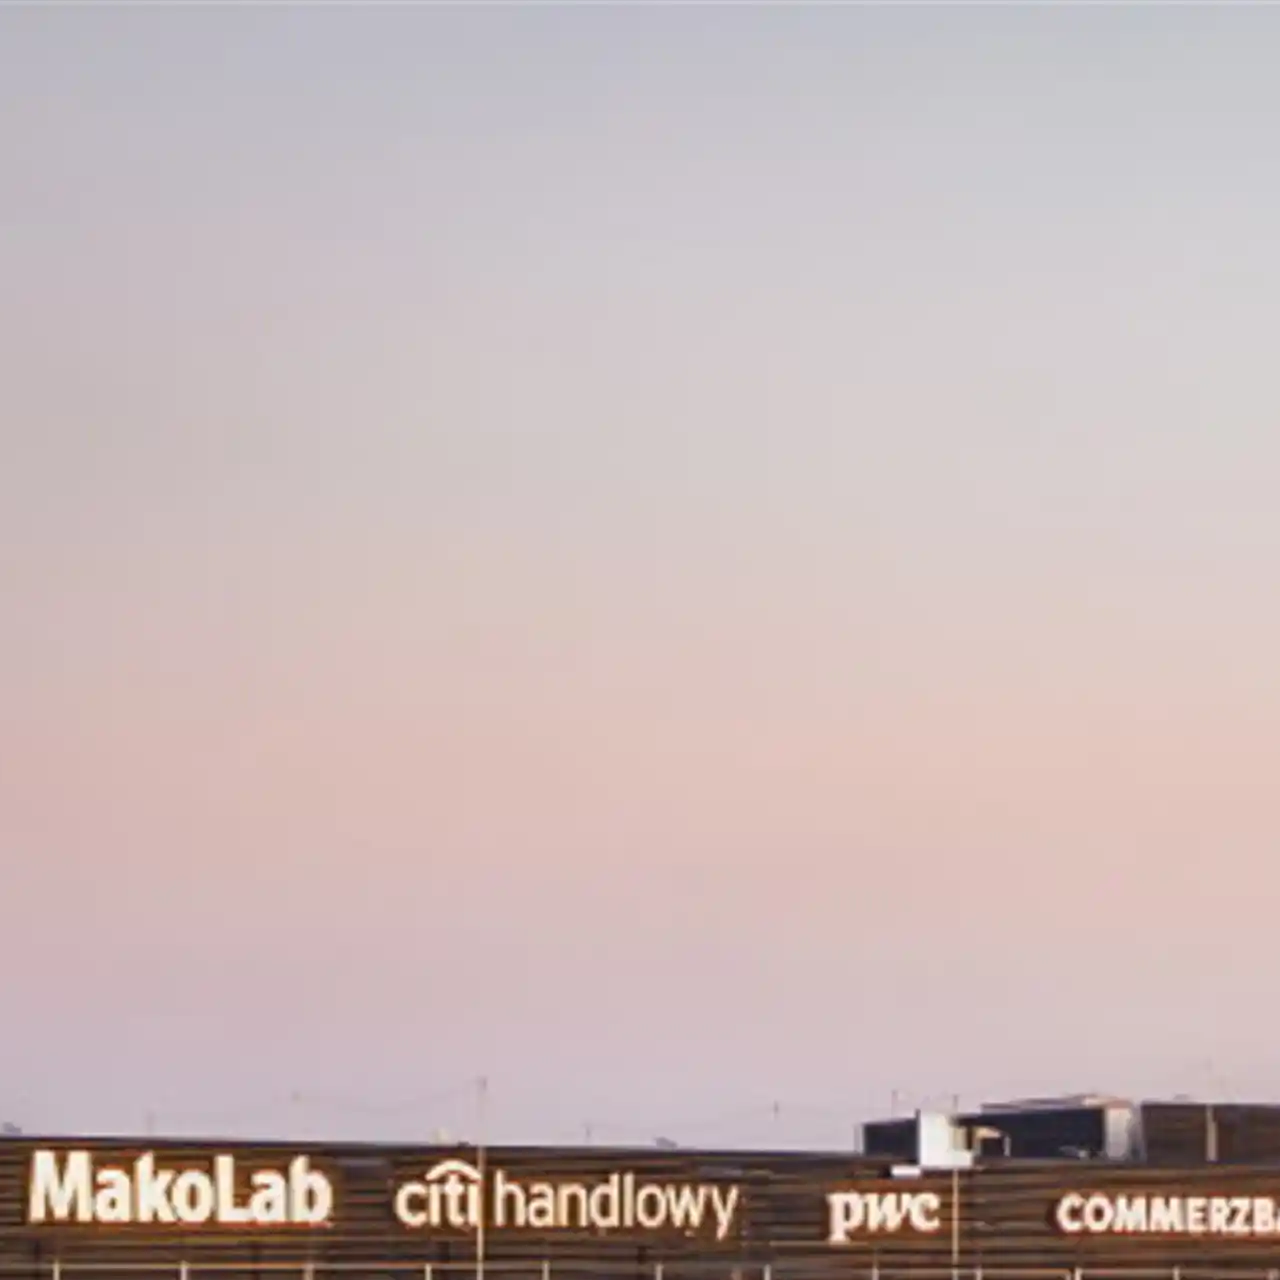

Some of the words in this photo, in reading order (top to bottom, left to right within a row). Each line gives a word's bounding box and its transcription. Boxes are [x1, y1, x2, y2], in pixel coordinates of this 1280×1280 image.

[28, 1149, 333, 1224] MakoLab
[394, 1164, 484, 1227] citi
[495, 1171, 739, 1239] handlowy
[827, 1190, 941, 1244] pwc
